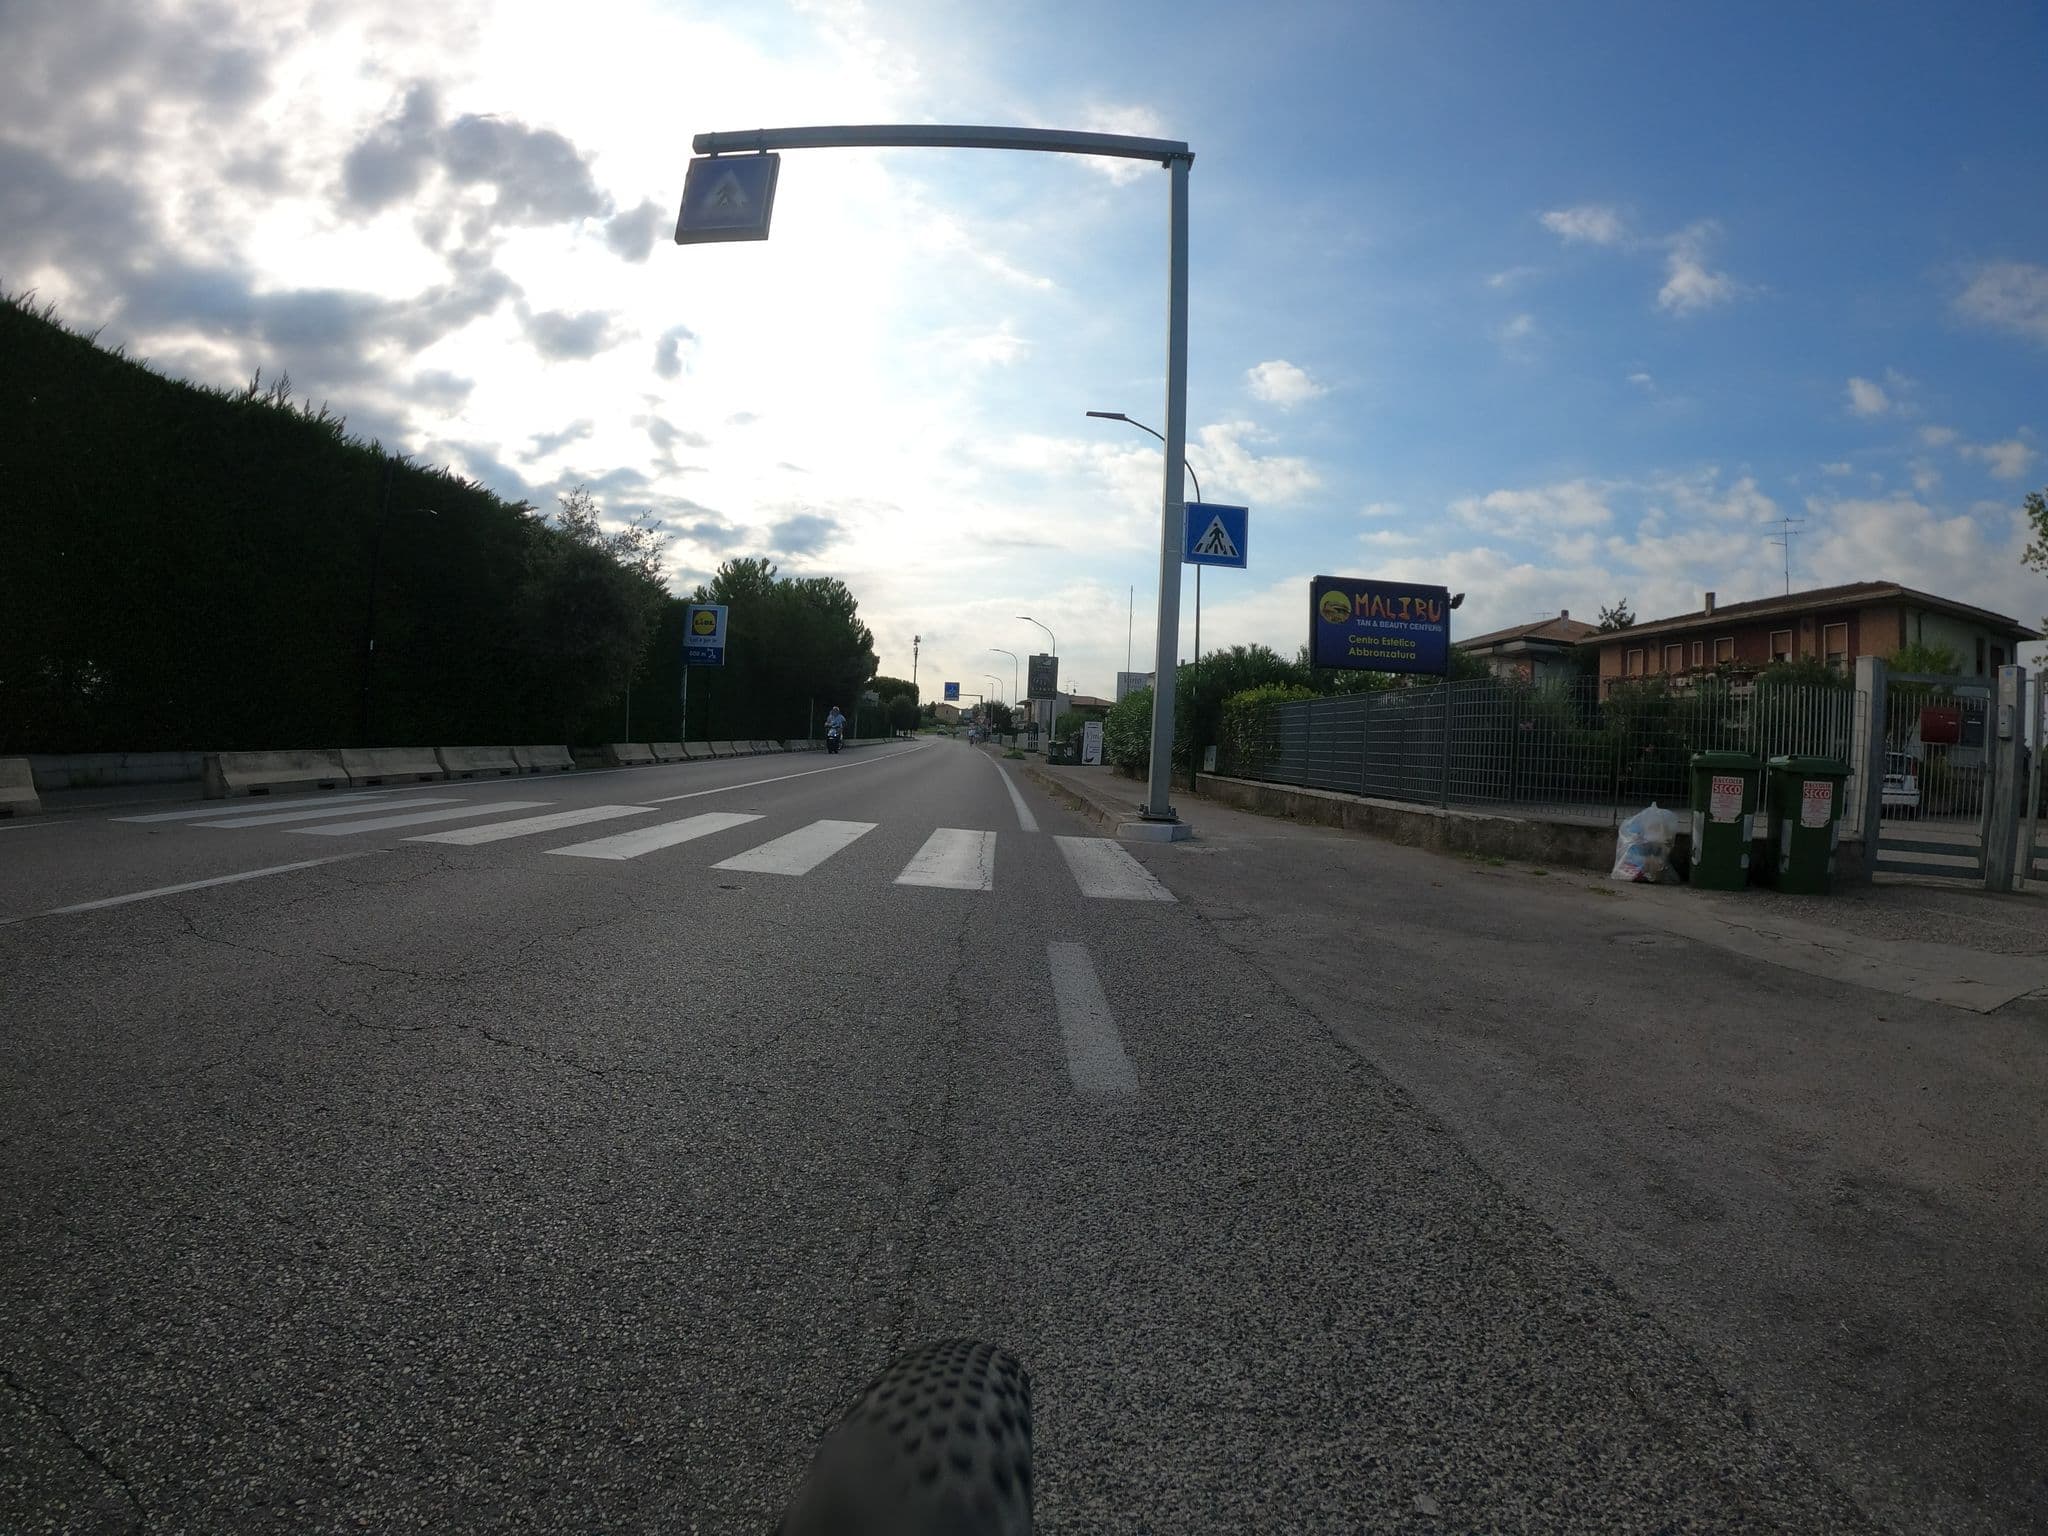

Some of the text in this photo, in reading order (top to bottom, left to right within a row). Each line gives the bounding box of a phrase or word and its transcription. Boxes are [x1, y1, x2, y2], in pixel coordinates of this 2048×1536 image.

[1355, 592, 1441, 623] MALIBU
[1357, 619, 1371, 627] TAN
[1373, 620, 1379, 628] &
[1380, 621, 1408, 630] BEAUTY
[1348, 634, 1416, 648] Centro Estetico
[1348, 647, 1416, 659] Abbronzatura
[1714, 784, 1741, 794] SECCO
[1804, 790, 1830, 799] SECCO
